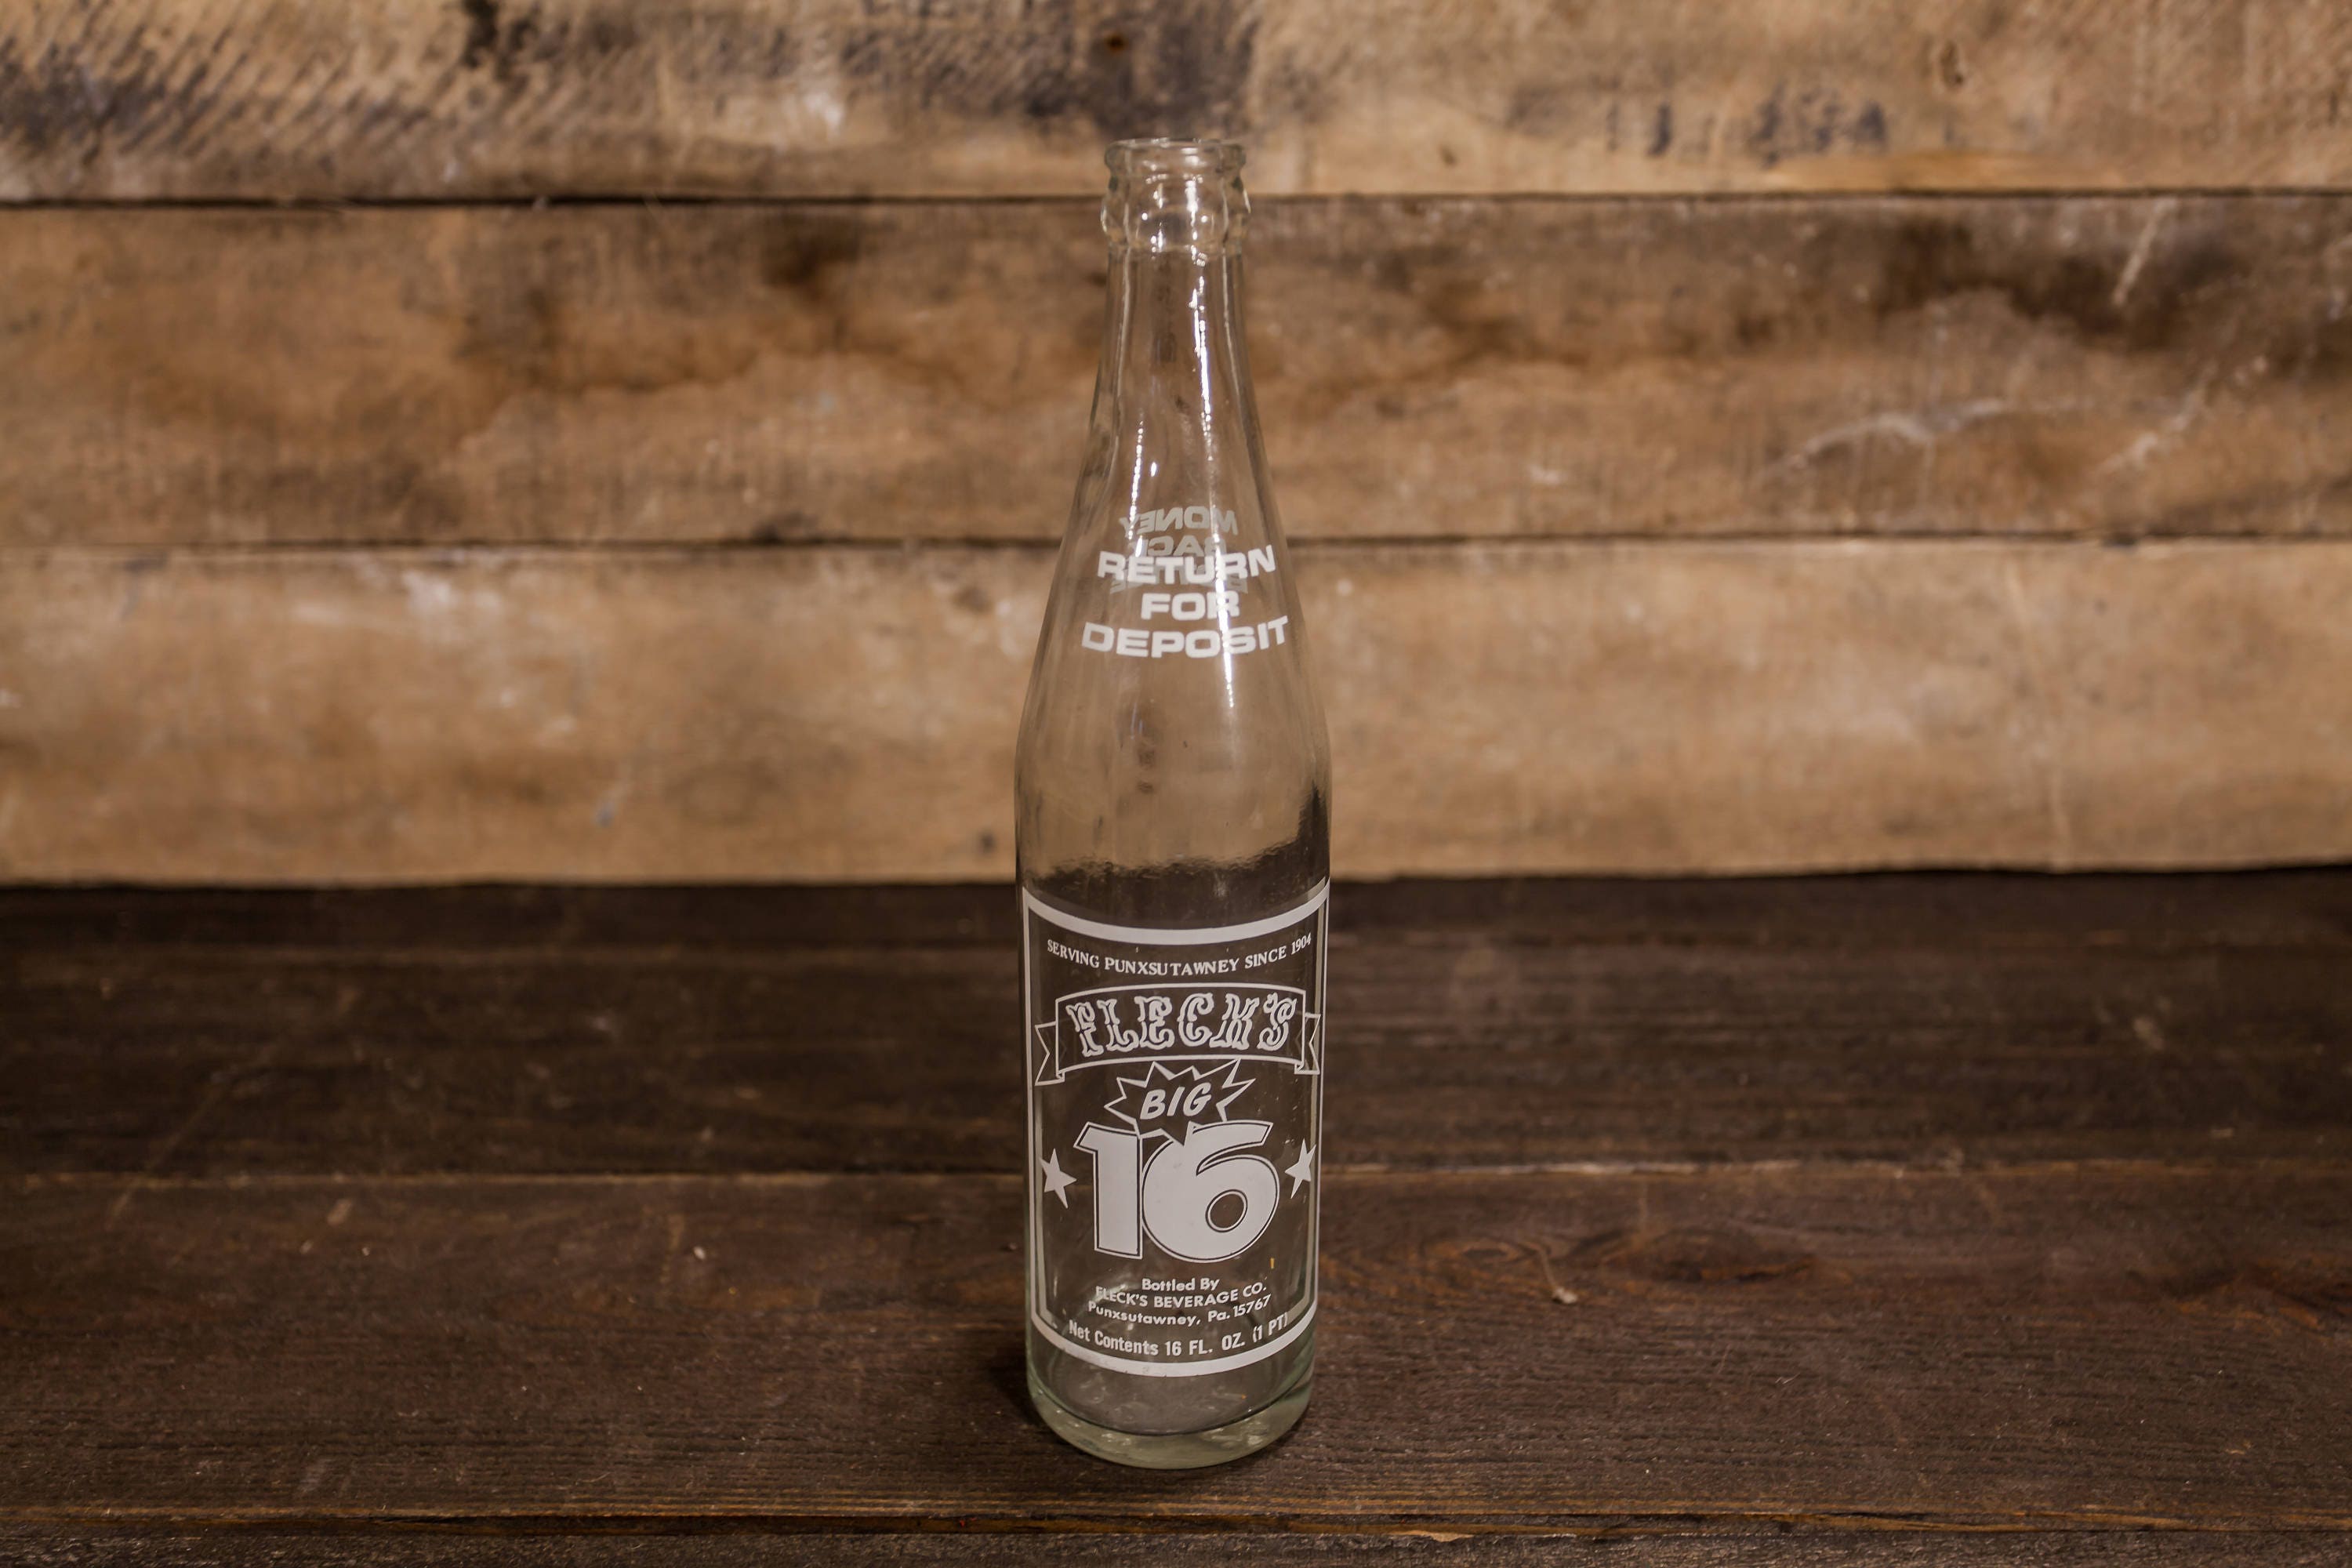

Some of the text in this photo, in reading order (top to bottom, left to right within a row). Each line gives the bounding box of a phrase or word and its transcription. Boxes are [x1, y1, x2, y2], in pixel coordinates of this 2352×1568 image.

[1097, 544, 1276, 584] RETURN
[1141, 590, 1240, 620] FOR
[1081, 615, 1288, 659] DEPOSIT
[1047, 933, 1312, 976] SERVING PUNXSUTAWNEY SINCE 1904
[1065, 992, 1298, 1058] FLECK'S
[1140, 1083, 1212, 1120] BIG
[1073, 1120, 1281, 1264] 16
[1095, 1282, 1267, 1308] FLECK'S BEVERAGE CO.
[1142, 1278, 1220, 1292] Bottled By
[1088, 1293, 1272, 1327] Punxsutawney, Pa. 15767
[1069, 1311, 1288, 1357] Net Contents 16 FL. OZ. (1 PT)
